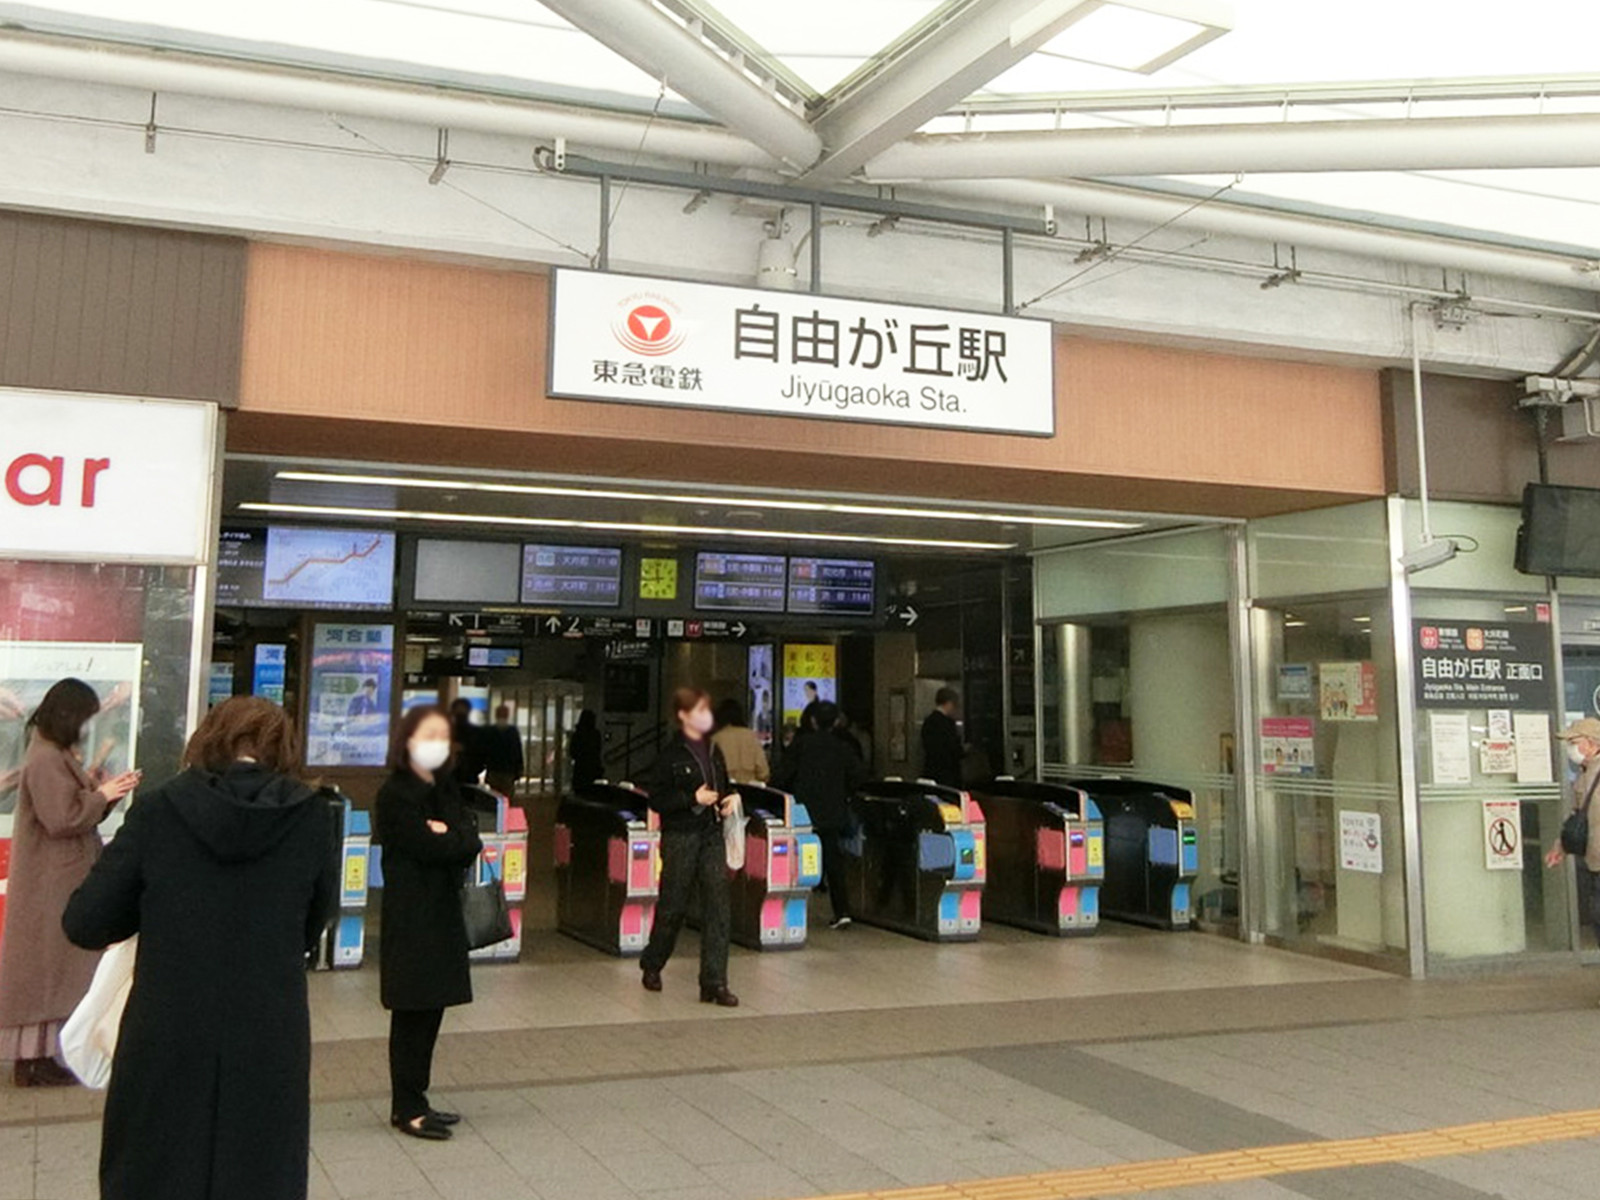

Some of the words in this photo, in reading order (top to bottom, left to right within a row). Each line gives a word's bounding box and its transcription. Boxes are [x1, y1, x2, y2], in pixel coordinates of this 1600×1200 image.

[734, 303, 1008, 384] 自由が丘駅
[593, 359, 703, 392] 東急電鉄
[781, 374, 911, 410] Jiyūgaoka
[920, 387, 967, 413] Sta.
[1421, 656, 1502, 680] 自由が丘駅
[1506, 662, 1543, 681] 正面口
